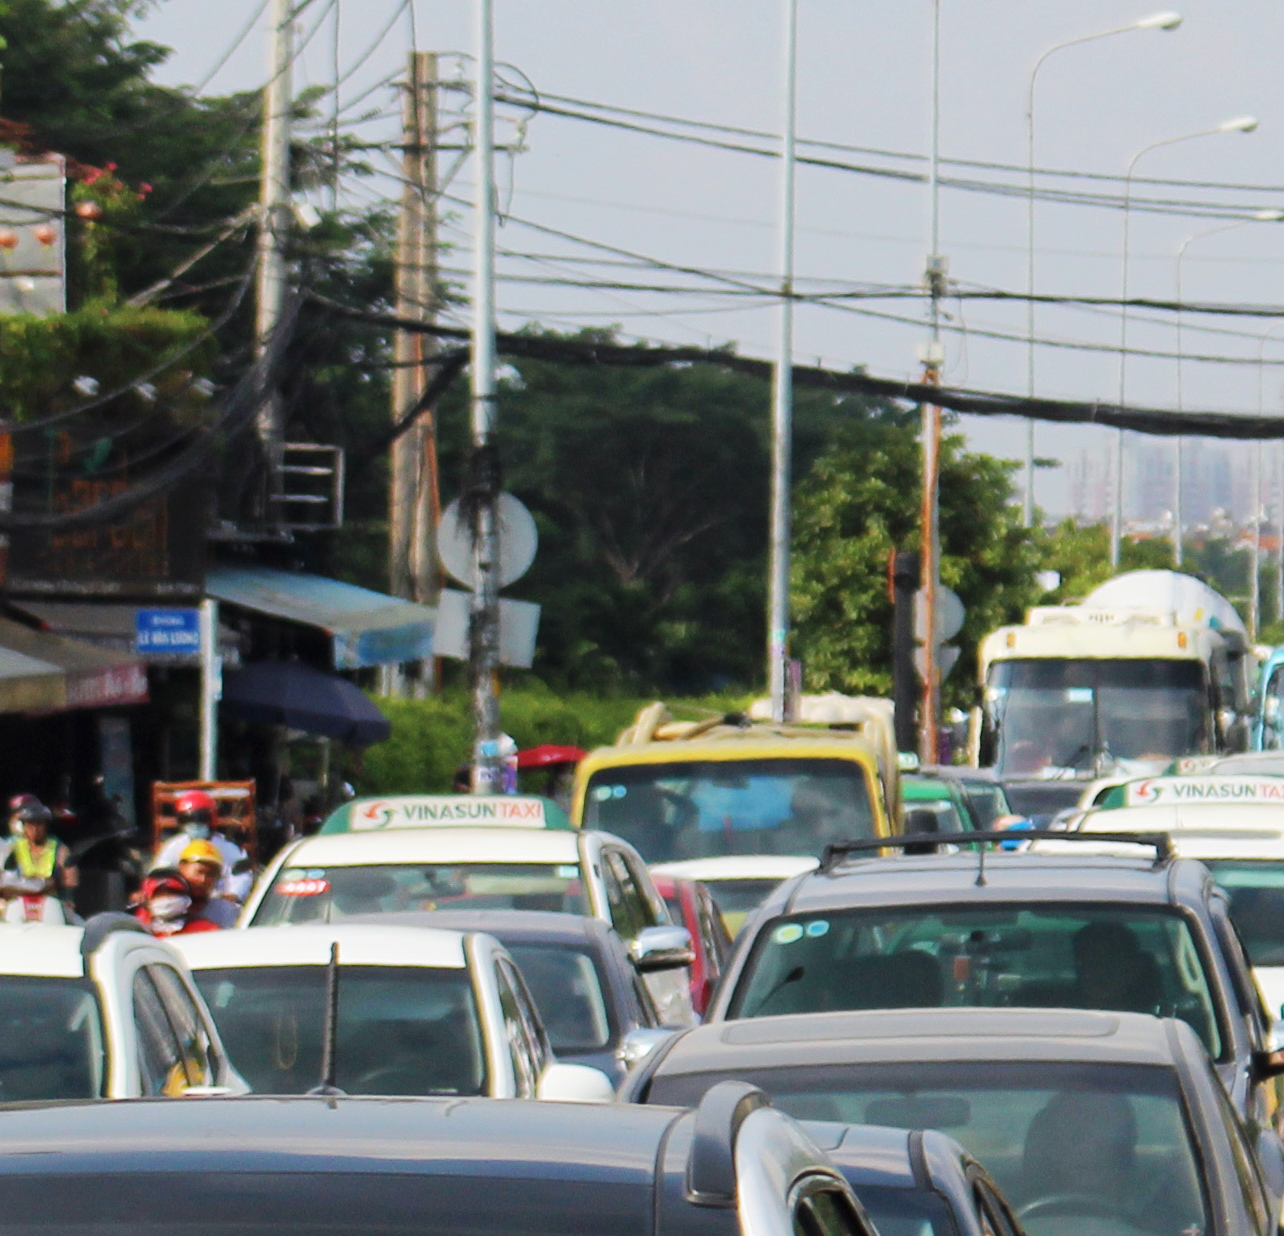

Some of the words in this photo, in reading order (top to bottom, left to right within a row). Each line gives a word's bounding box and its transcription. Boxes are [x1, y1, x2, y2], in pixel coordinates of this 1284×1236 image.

[1173, 783, 1256, 798] VINASUN
[403, 803, 496, 821] VINASUN
[500, 802, 542, 818] TAXI
